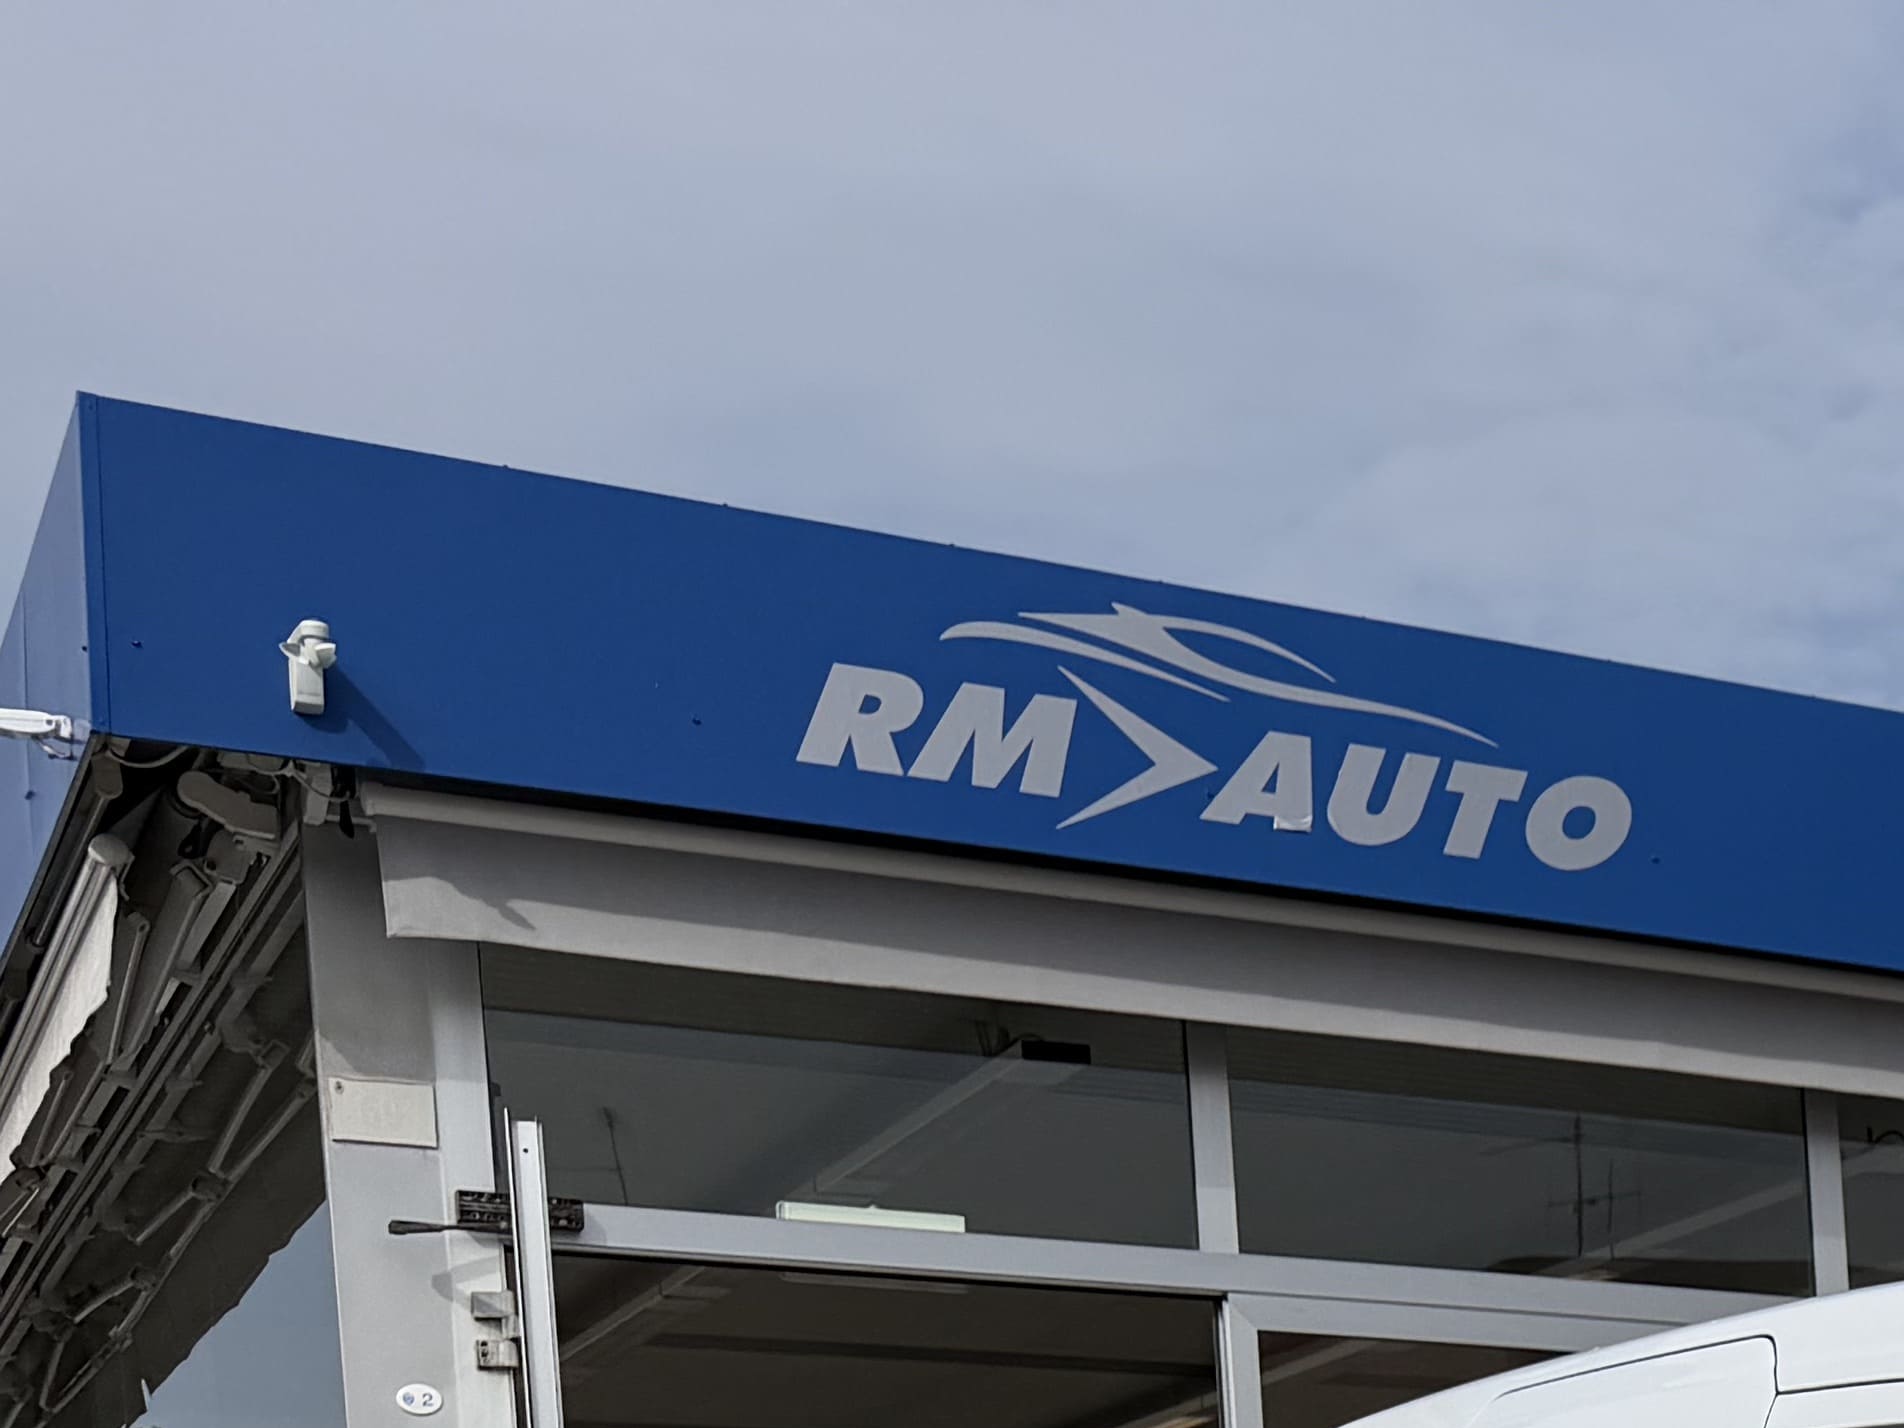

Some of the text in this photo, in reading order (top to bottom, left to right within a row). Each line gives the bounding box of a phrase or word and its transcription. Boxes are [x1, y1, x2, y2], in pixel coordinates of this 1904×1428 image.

[795, 661, 1633, 871] RM AUTO
[422, 1392, 433, 1407] 2
